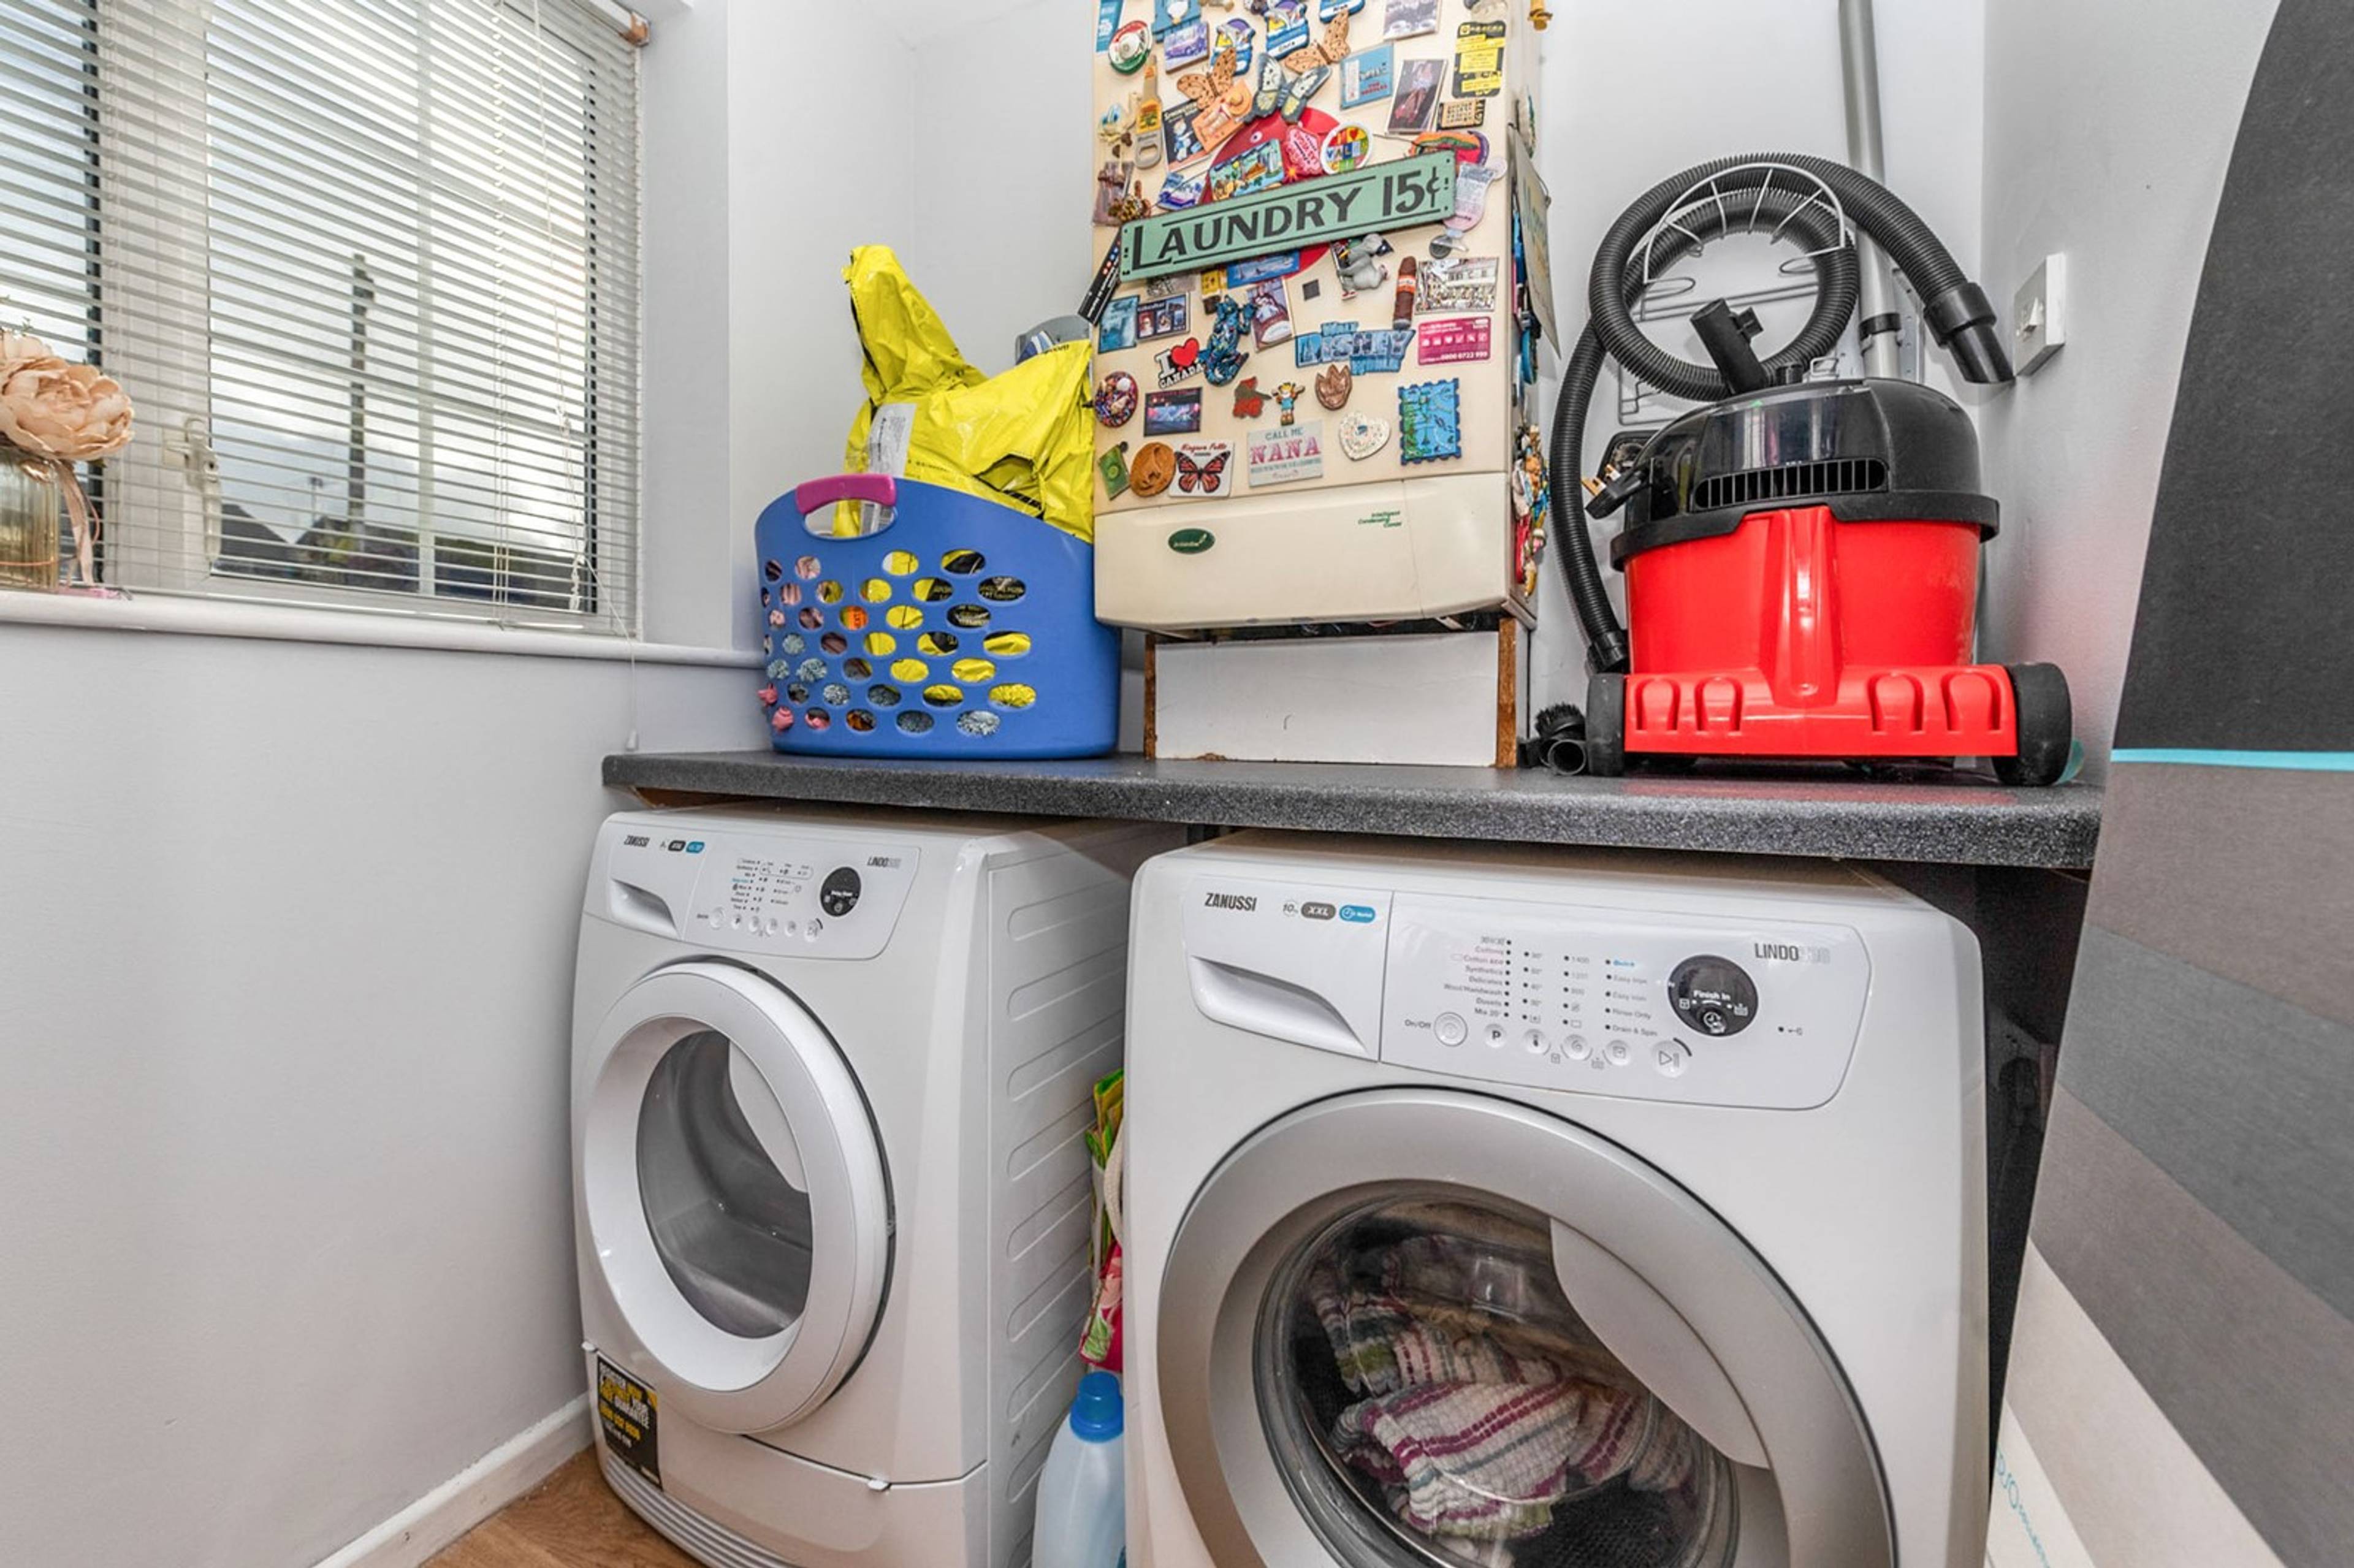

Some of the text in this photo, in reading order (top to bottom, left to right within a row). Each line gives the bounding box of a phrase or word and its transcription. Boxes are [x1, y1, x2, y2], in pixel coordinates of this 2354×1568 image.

[1131, 186, 1363, 270] LAUNDRY
[1159, 363, 1205, 389] CANADA
[1250, 436, 1322, 465] NANA
[1204, 892, 1257, 912] ZANUSSI
[1693, 989, 1720, 1000] Finish
[1491, 1030, 1501, 1040] P
